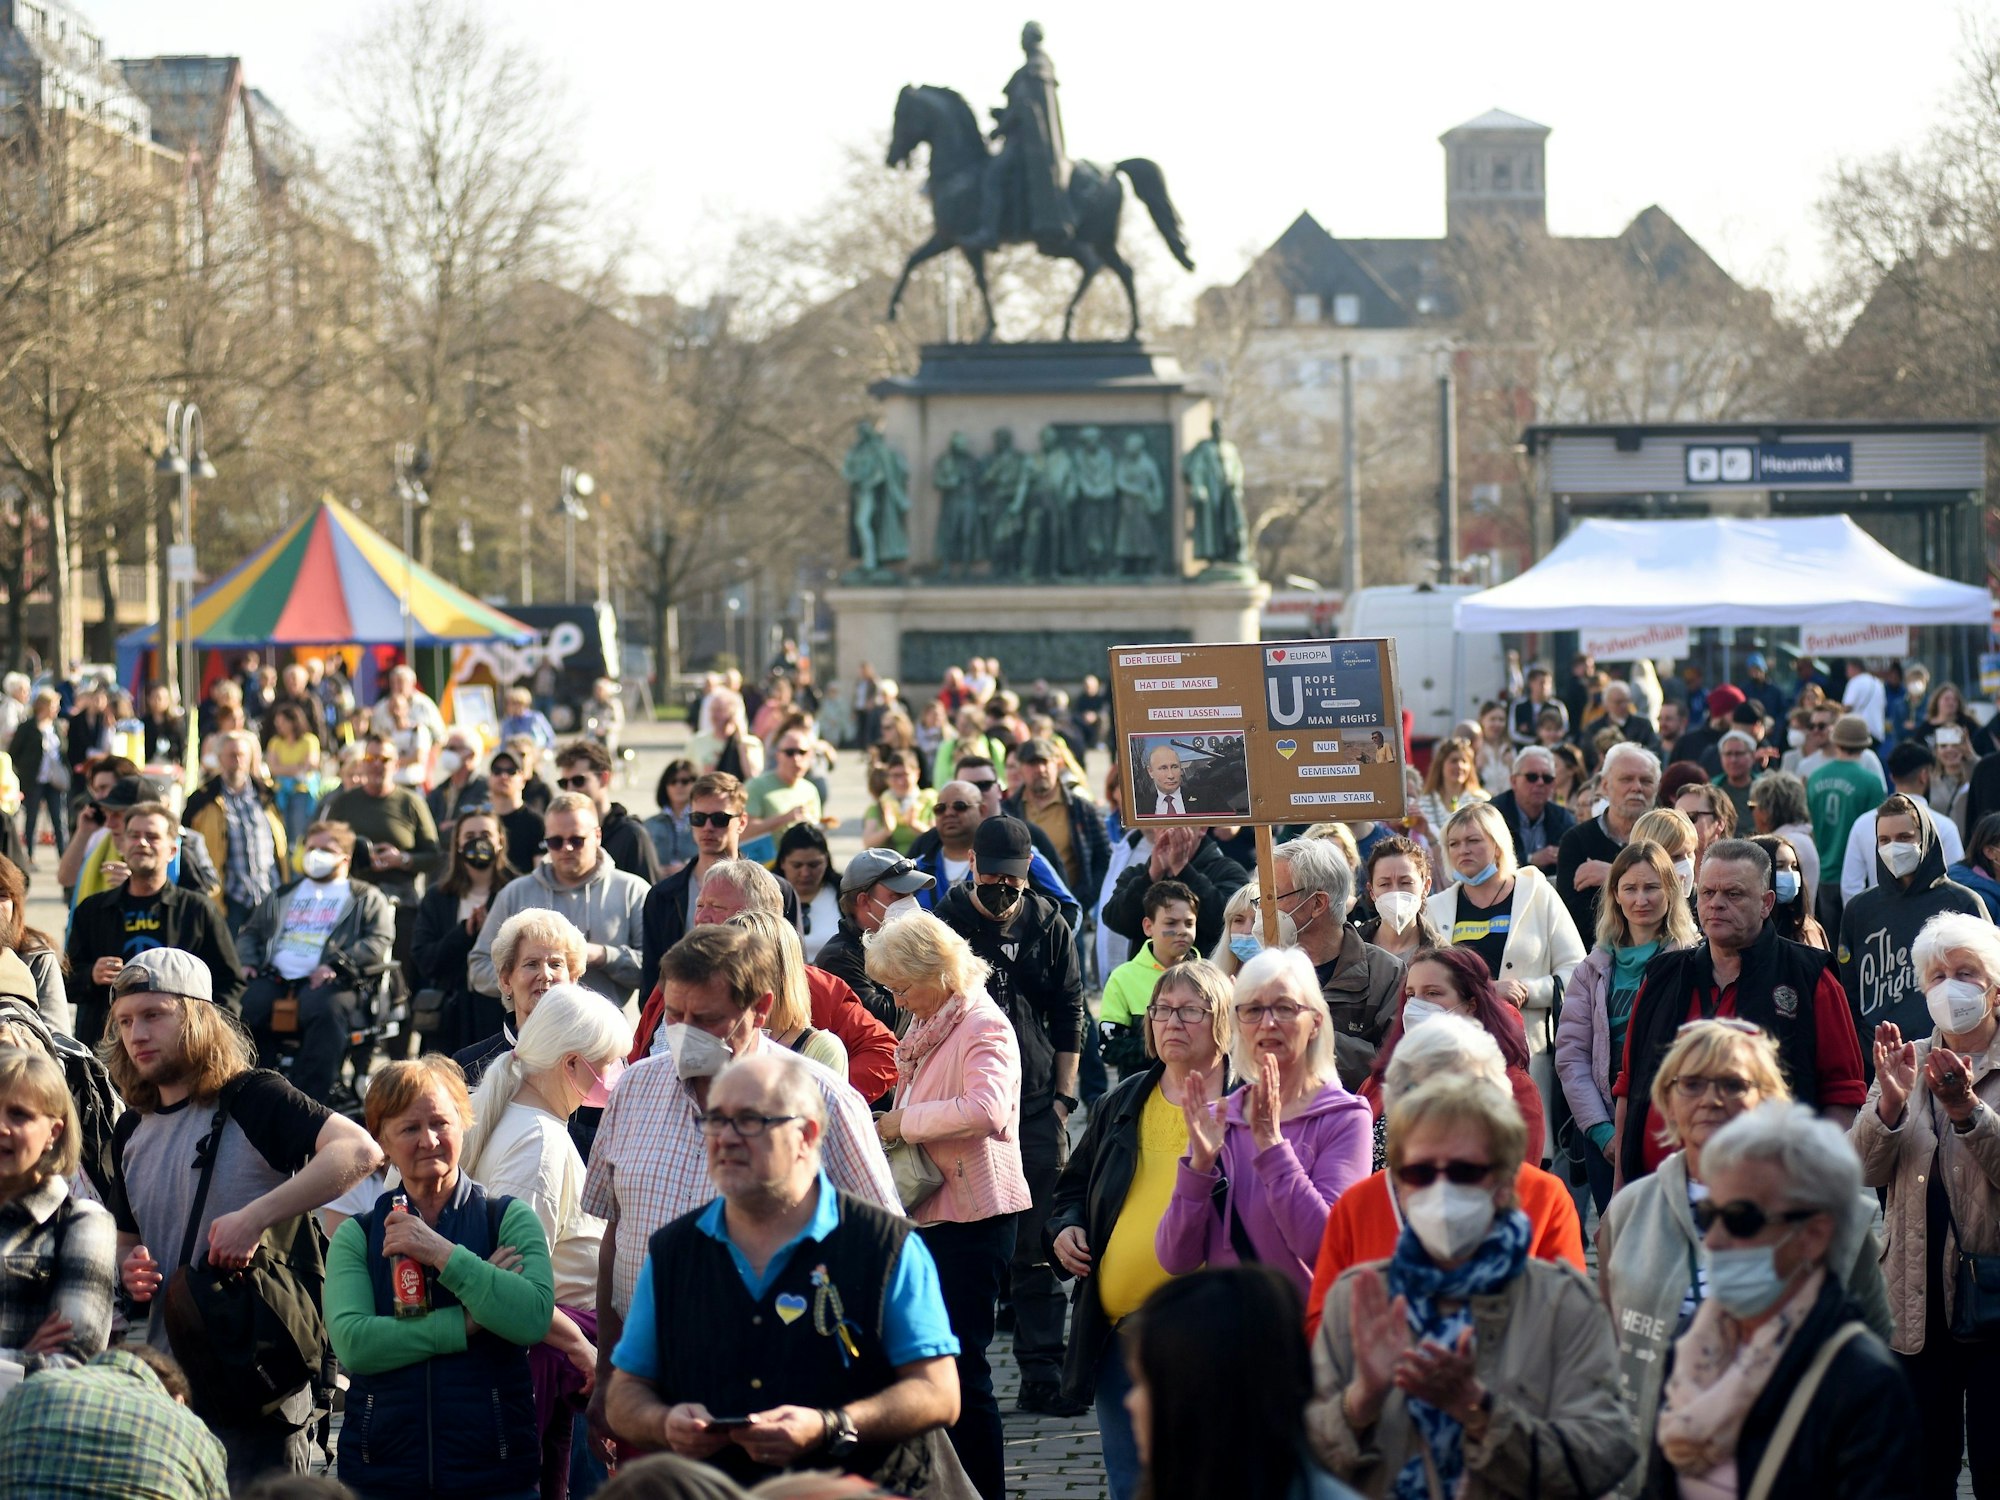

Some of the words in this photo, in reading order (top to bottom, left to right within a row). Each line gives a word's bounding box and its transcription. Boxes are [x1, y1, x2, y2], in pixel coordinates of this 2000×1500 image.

[1761, 453, 1845, 473] Heumarkt
[1125, 656, 1142, 665] DER
[1146, 655, 1177, 664] TEUFEL
[1289, 651, 1328, 661] EUROPA
[1139, 682, 1157, 690] HAT
[1161, 681, 1176, 689] DIE
[1182, 679, 1212, 688] MASKE
[1305, 675, 1336, 684] ROPE
[1305, 687, 1337, 697] NITE
[1268, 676, 1304, 726] U
[1153, 709, 1184, 718] FALLEN
[1188, 708, 1220, 717] LASSEN
[1308, 716, 1333, 725] MAN
[1340, 713, 1377, 724] RIGHTS
[1316, 742, 1337, 751] NUR
[1301, 766, 1357, 776] GEMEINSAM
[1293, 795, 1314, 804] SIND
[1318, 794, 1337, 803] WIR
[1343, 793, 1371, 802] STARK
[1825, 792, 1840, 826] 9
[1864, 927, 1908, 979] The
